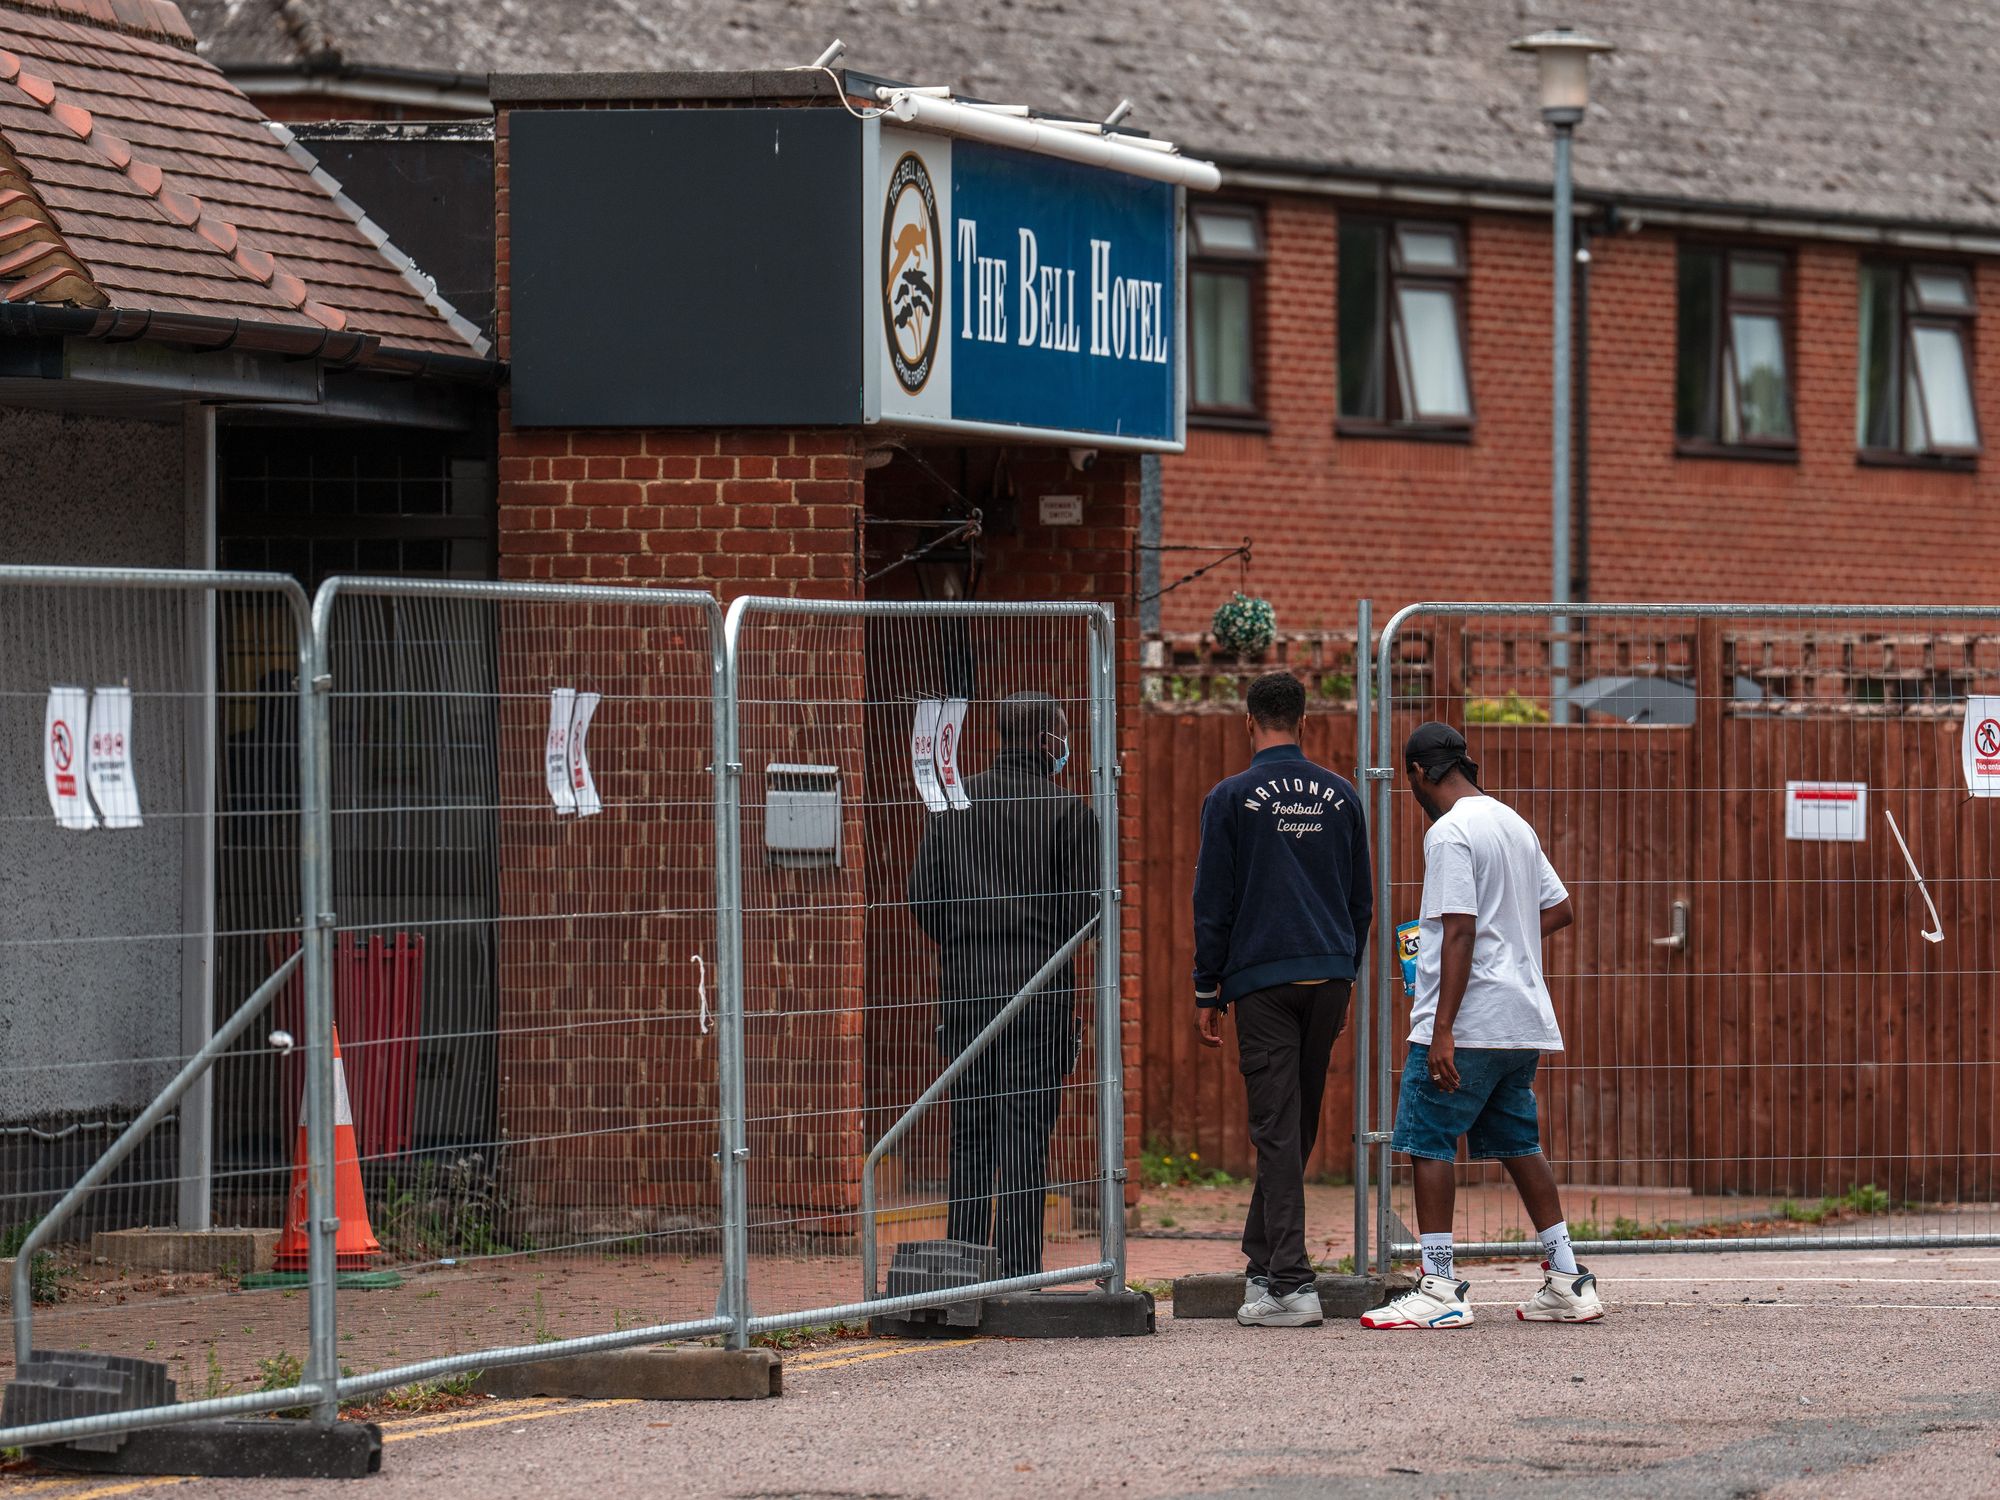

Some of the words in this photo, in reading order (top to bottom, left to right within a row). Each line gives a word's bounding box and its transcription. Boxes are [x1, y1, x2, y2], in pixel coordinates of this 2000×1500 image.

[889, 171, 902, 206] THE
[901, 160, 916, 183] BELL
[916, 164, 934, 216] HOTEL
[958, 218, 1007, 344] THE
[1018, 227, 1080, 352] BELL
[1090, 239, 1167, 364] HOTEL
[911, 356, 928, 385] FOREST
[1977, 763, 1987, 771] No
[1244, 778, 1345, 812] NATIONAL
[1272, 801, 1324, 815] Football
[1277, 818, 1323, 839] League
